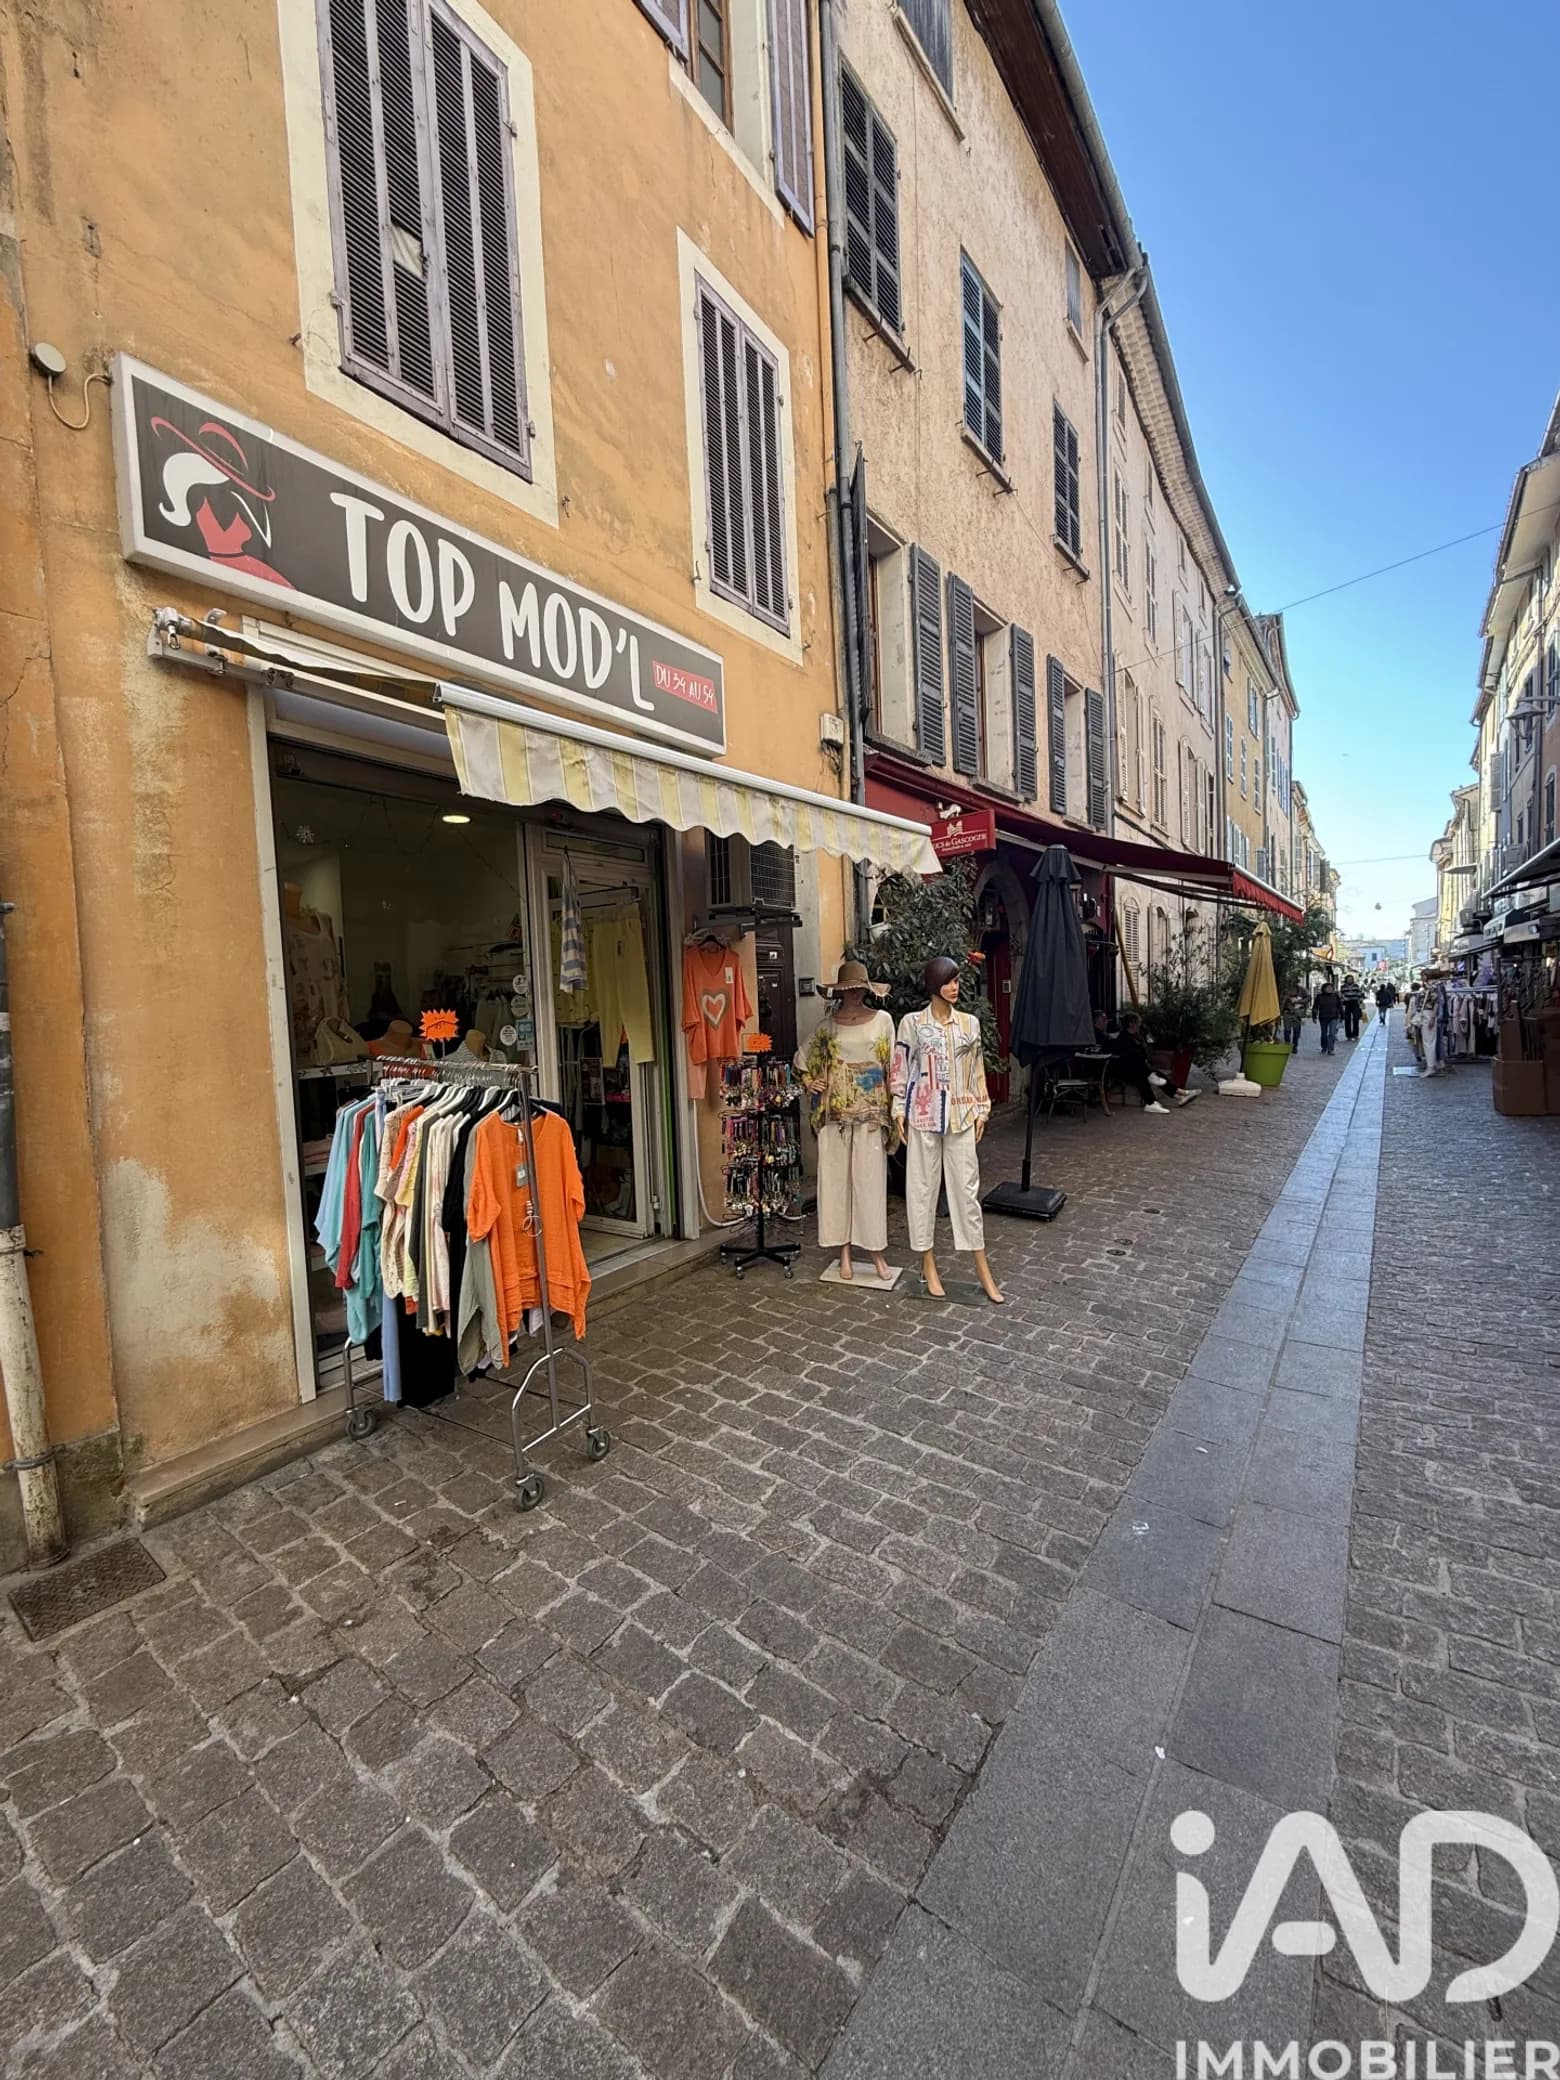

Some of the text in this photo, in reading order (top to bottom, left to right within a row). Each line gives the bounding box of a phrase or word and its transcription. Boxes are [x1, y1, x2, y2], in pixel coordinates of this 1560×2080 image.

[330, 492, 655, 711] TOP MOD'L
[656, 664, 715, 704] DU 34 AU 54
